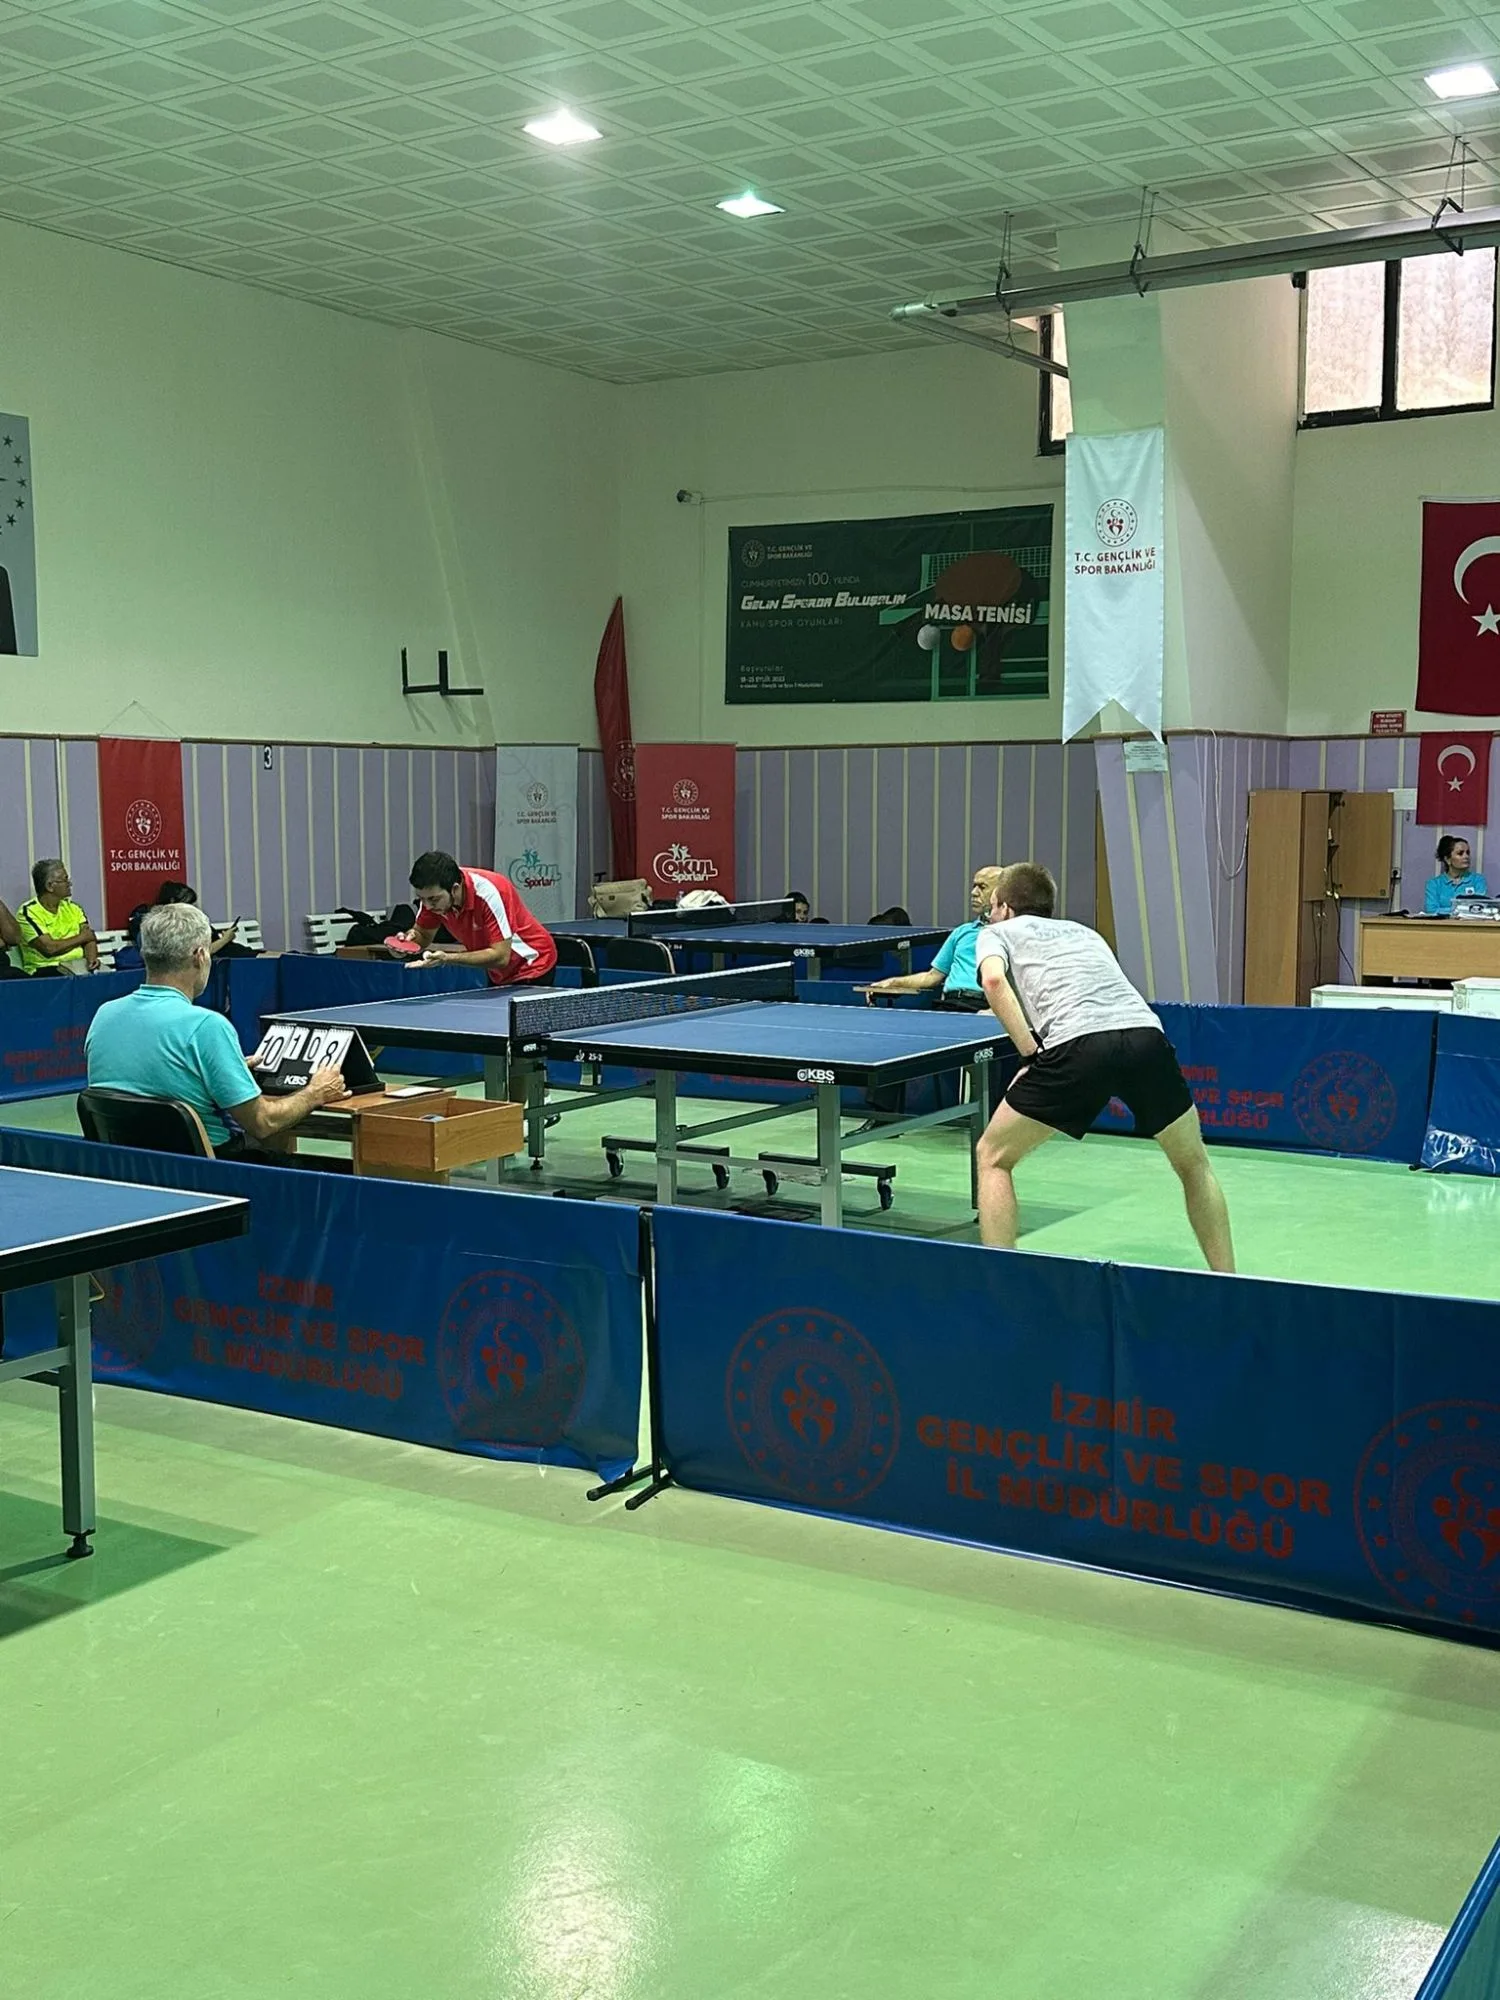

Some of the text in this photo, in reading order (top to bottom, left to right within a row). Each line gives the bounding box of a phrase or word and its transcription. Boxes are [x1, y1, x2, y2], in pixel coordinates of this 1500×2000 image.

[1074, 547, 1156, 564] T.C. GENÇLİK VE
[1074, 558, 1156, 576] SPOR BAKANLIĞI
[768, 619, 793, 627] SPOR
[797, 617, 843, 627] OYUNLARI
[924, 601, 1032, 624] MASA TENİSİ
[264, 746, 273, 768] 3
[110, 849, 180, 860] T.C. GENÇLİK VE
[110, 860, 180, 871] SPOR BAKANLIĞI
[662, 858, 718, 878] OKUL
[261, 1035, 284, 1066] 10
[290, 1034, 301, 1057] 1
[307, 1036, 321, 1060] 0
[284, 1075, 308, 1086] KBS
[808, 1068, 835, 1081] KBS
[1228, 1089, 1284, 1109] SPOR
[258, 1272, 333, 1309] İZMİR
[174, 1296, 427, 1365] GENÇLİK VE SPOR
[193, 1334, 402, 1400] İL MÜDÜRLÜĞÜ
[1051, 1382, 1178, 1443] İZMİR
[916, 1414, 1331, 1517] GENÇLİK VE SPOR
[946, 1458, 1294, 1559] İL MÜDÜRLÜĞÜ
